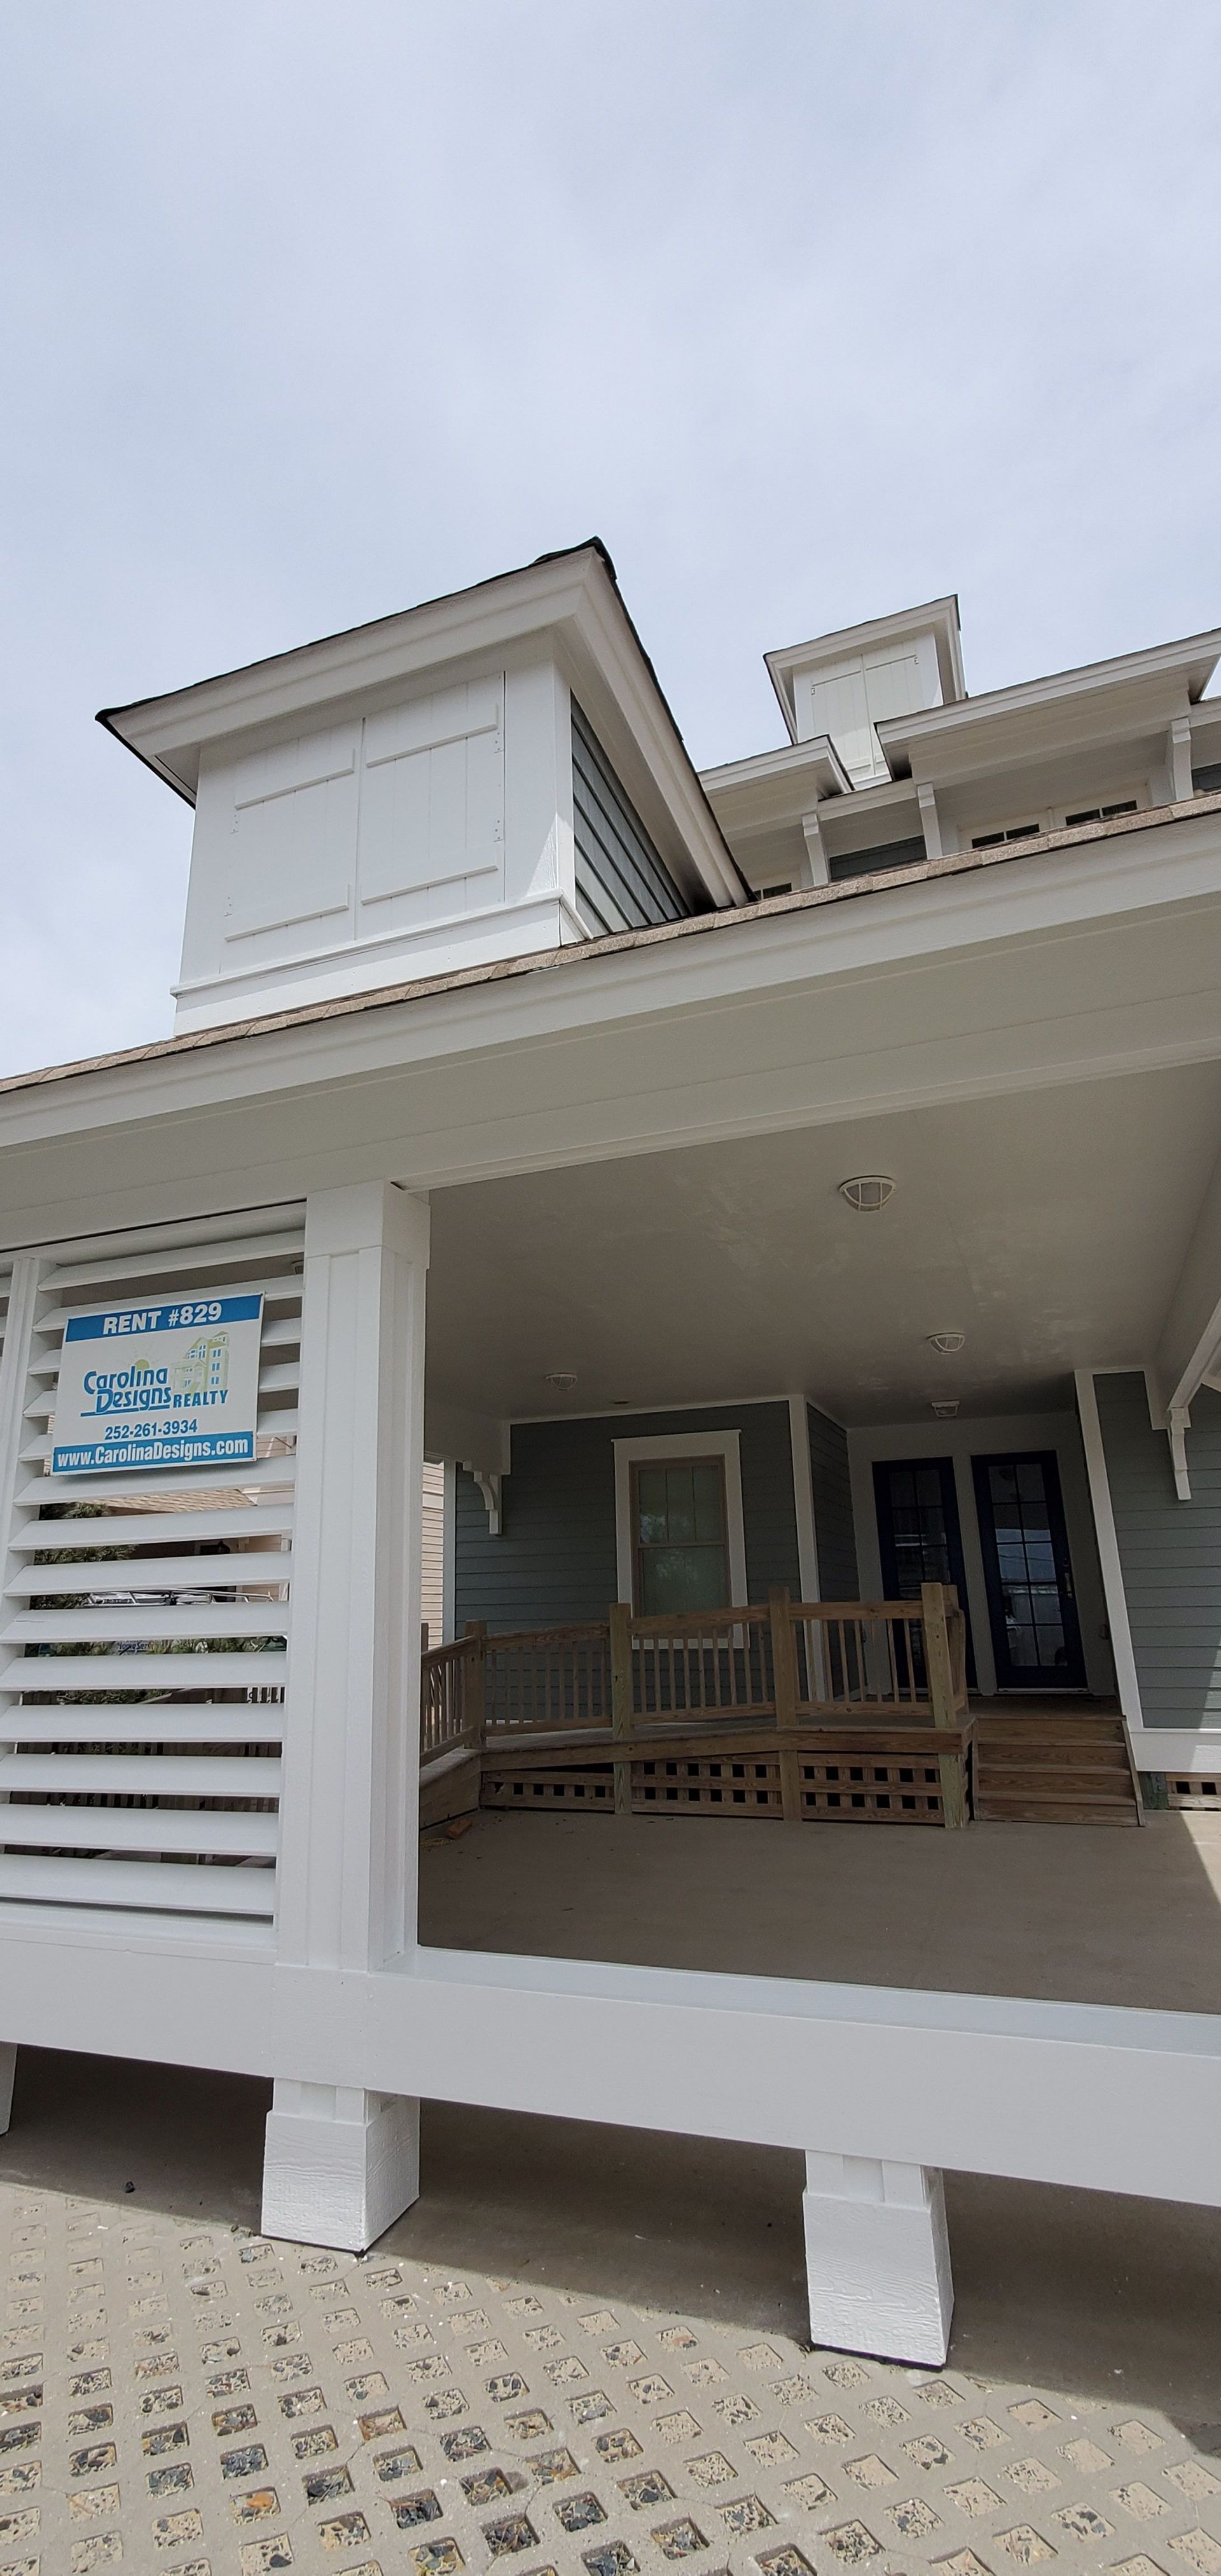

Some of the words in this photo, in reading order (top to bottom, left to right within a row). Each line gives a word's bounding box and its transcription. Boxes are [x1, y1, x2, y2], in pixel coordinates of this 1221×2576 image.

[102, 1311, 162, 1335] RENT
[168, 1302, 222, 1327] #829
[84, 1365, 168, 1395] Carolina
[96, 1387, 172, 1413] Designs
[173, 1389, 228, 1408] REALTY
[104, 1419, 198, 1440] 252-261-3934
[57, 1438, 248, 1466] www.CarolinaDesigns.com
